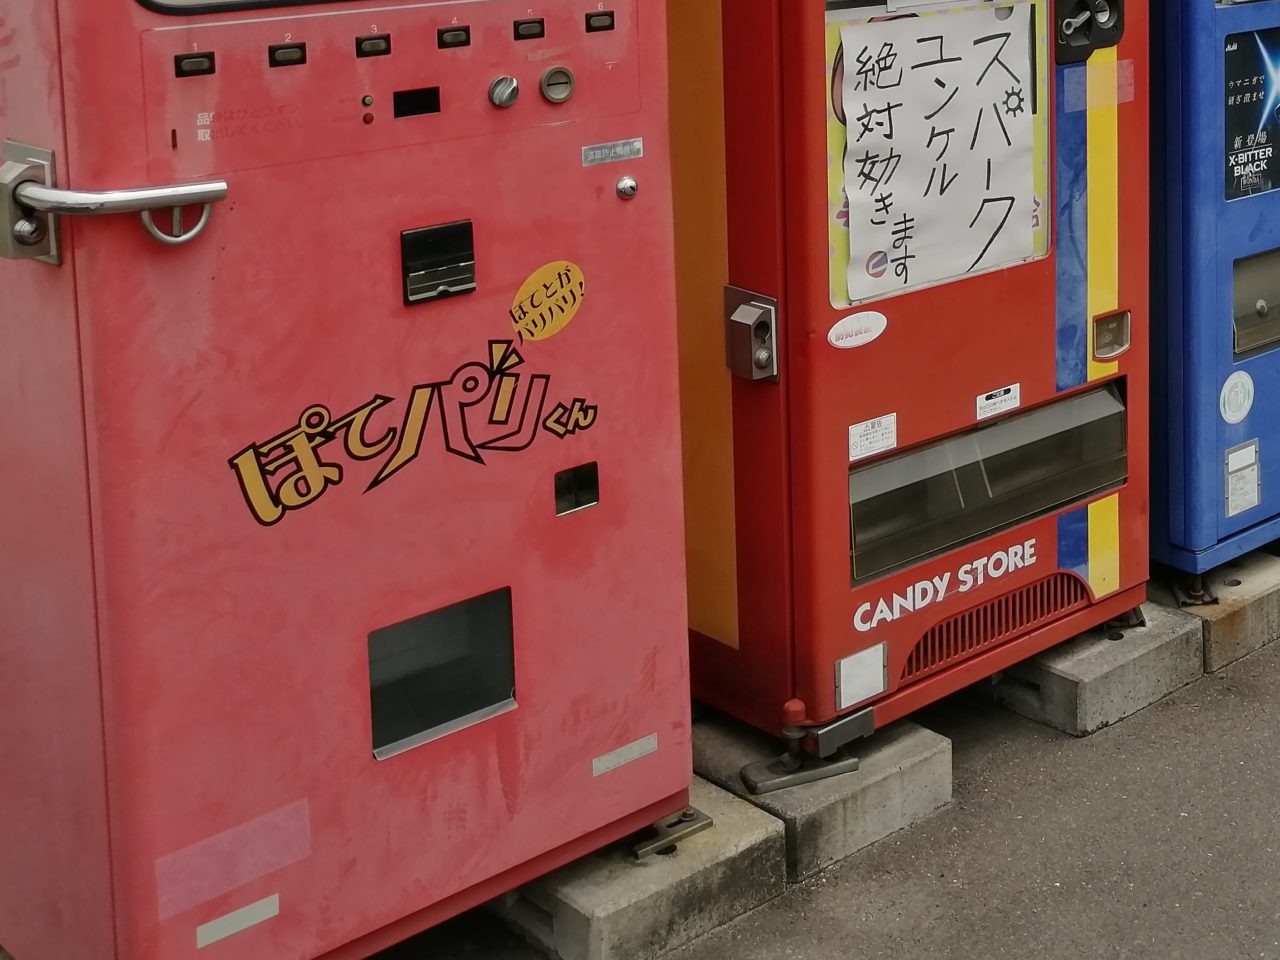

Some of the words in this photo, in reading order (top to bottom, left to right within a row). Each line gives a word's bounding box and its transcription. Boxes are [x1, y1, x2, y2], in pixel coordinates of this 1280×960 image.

[597, 2, 604, 11] 6
[370, 24, 378, 33] 3
[451, 16, 458, 24] 4
[284, 33, 292, 42] 2
[192, 43, 198, 51] 1
[911, 35, 962, 197] ユンケル
[854, 42, 916, 284] 絶対効きます
[1234, 159, 1268, 177] BLACK
[507, 265, 573, 326] ぽてとが
[516, 281, 586, 346] パリパリ!
[853, 571, 950, 632] CANDY
[957, 538, 1037, 593] STORE
